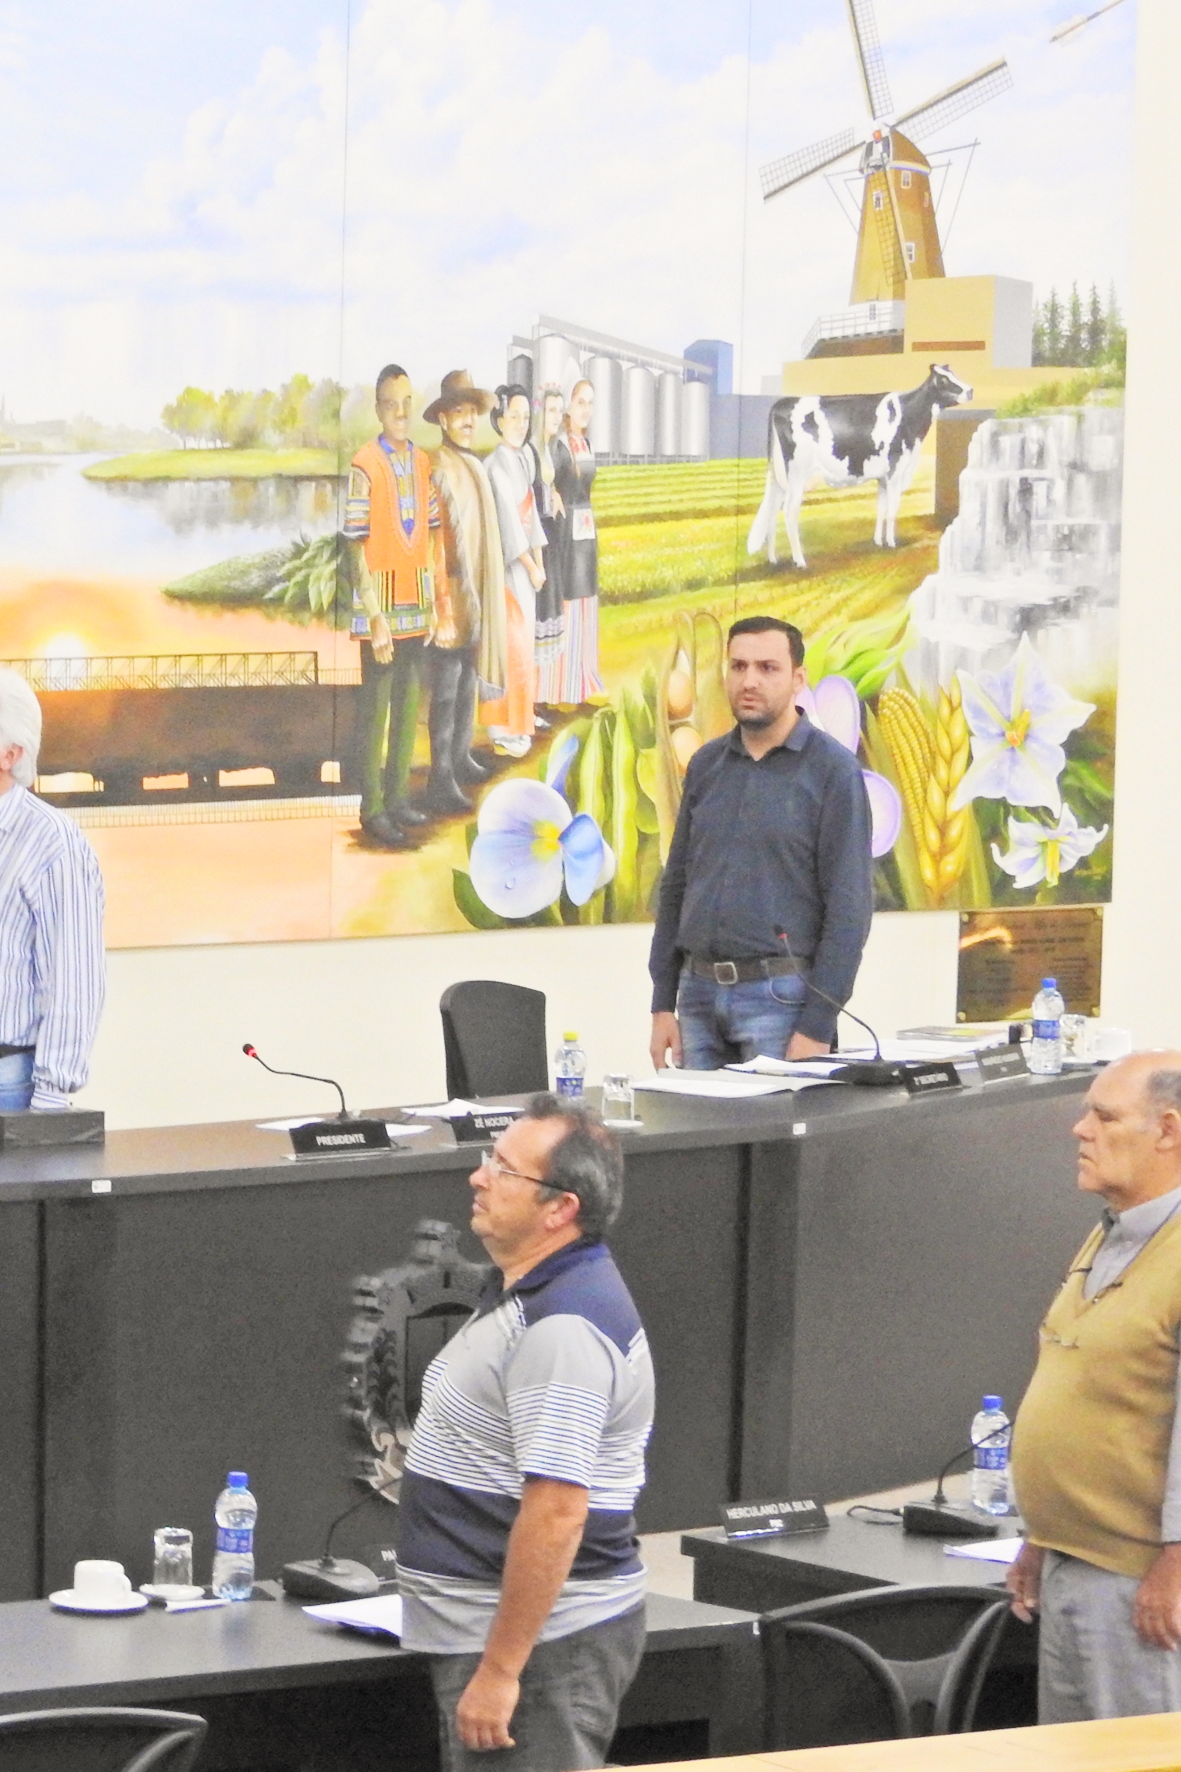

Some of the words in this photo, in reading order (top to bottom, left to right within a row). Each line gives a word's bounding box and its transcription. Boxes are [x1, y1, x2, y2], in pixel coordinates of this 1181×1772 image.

[315, 1133, 366, 1146] PRESIDENTE
[726, 1503, 779, 1519] HERCULANO
[778, 1502, 794, 1514] DA
[792, 1500, 817, 1512] SILVA
